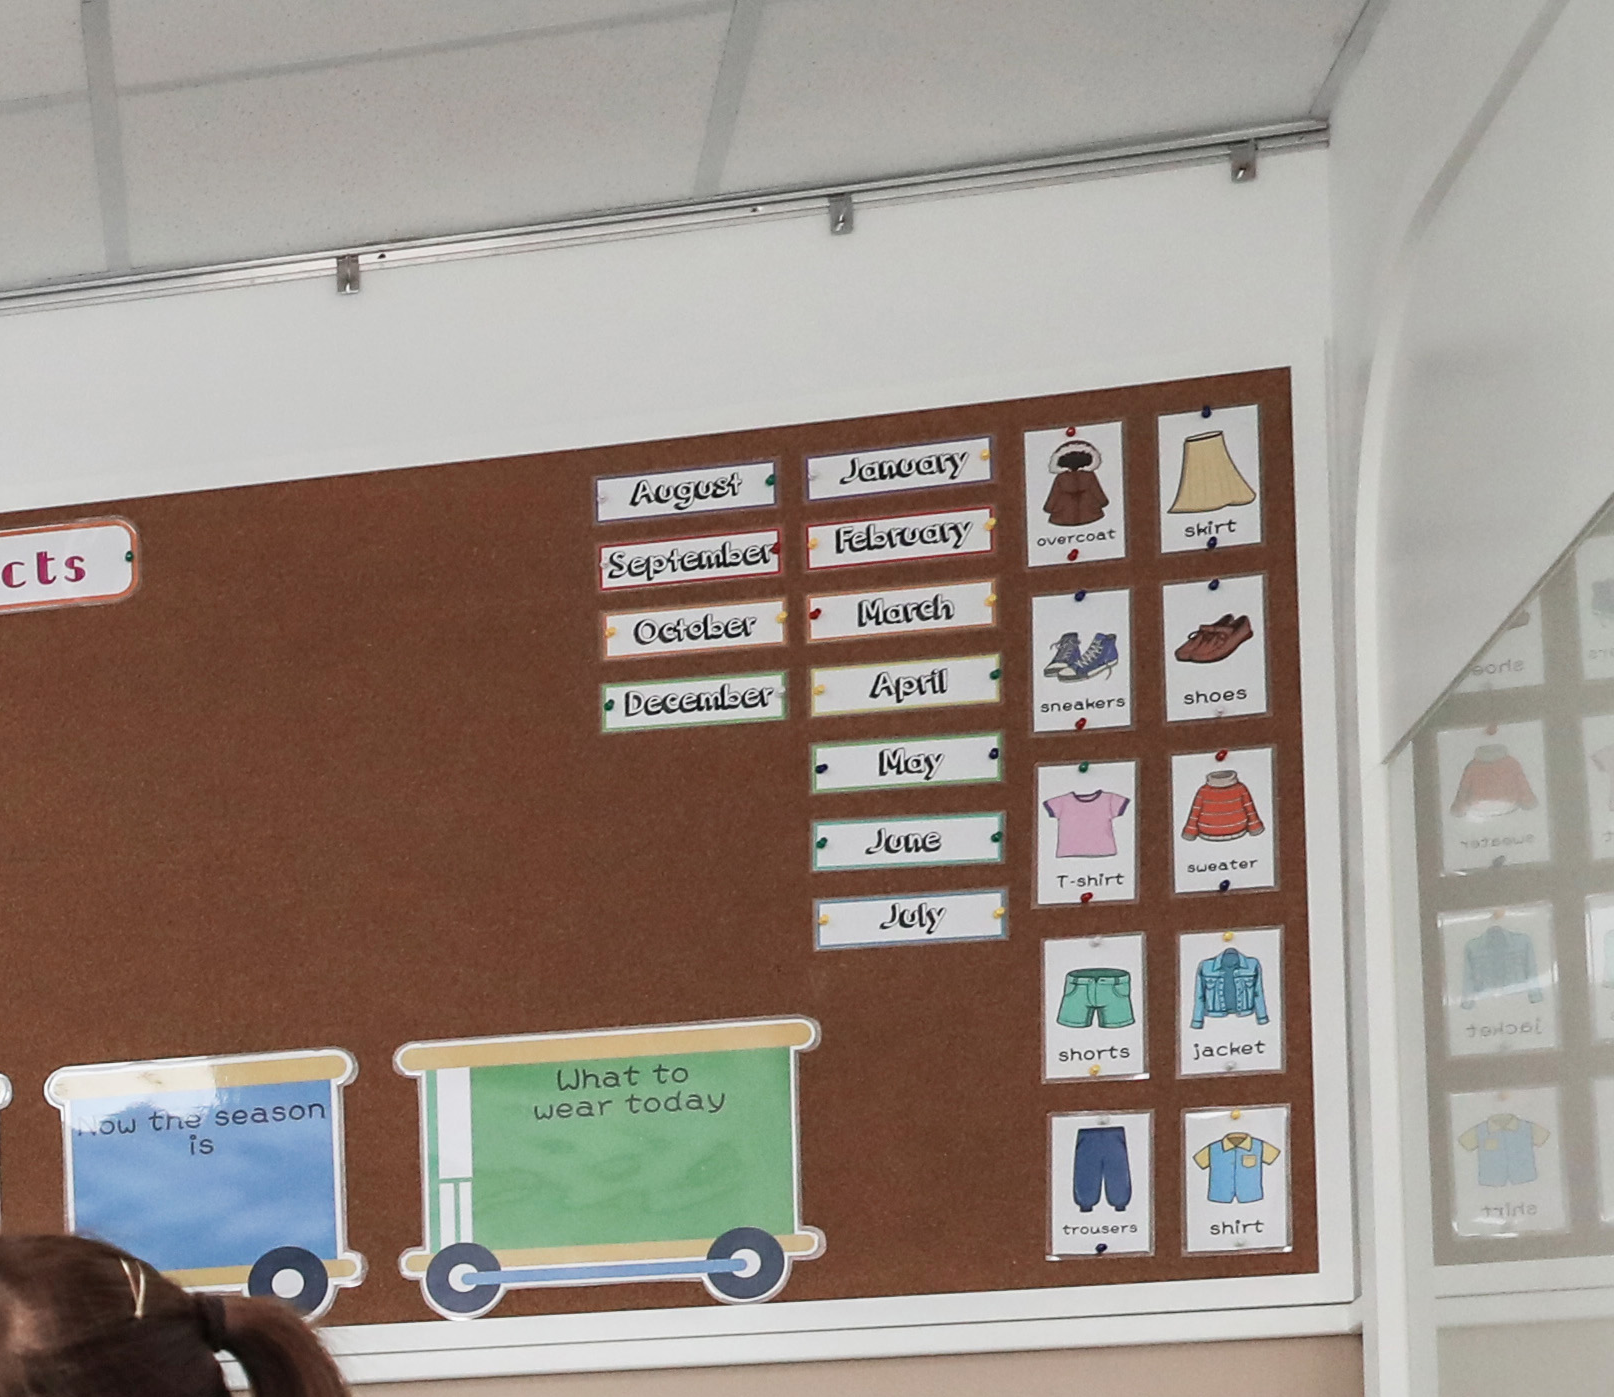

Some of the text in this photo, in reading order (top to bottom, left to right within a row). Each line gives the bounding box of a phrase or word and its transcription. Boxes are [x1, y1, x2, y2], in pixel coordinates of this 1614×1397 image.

[839, 450, 969, 486] January
[629, 473, 742, 510] August
[835, 520, 972, 554] February
[1037, 529, 1116, 546] overcoat
[1184, 519, 1237, 538] skirt
[607, 541, 774, 580] September
[857, 595, 954, 627] March
[634, 615, 757, 646] October
[869, 668, 949, 703] April
[1184, 688, 1247, 705] shoes
[624, 684, 774, 717] December
[1040, 697, 1125, 713] sneakers
[878, 747, 944, 781] May
[865, 828, 942, 855] June
[1187, 858, 1258, 873] sweater
[1057, 873, 1125, 888] T-shirt
[879, 902, 946, 934] July
[1059, 1045, 1130, 1062] shorts
[1193, 1040, 1266, 1060] jacket
[556, 1063, 690, 1091] What to
[78, 1102, 326, 1136] Now the season
[533, 1090, 727, 1122] wear today
[190, 1135, 214, 1155] is
[1062, 1220, 1139, 1238] trousers
[1208, 1217, 1265, 1237] shirt
